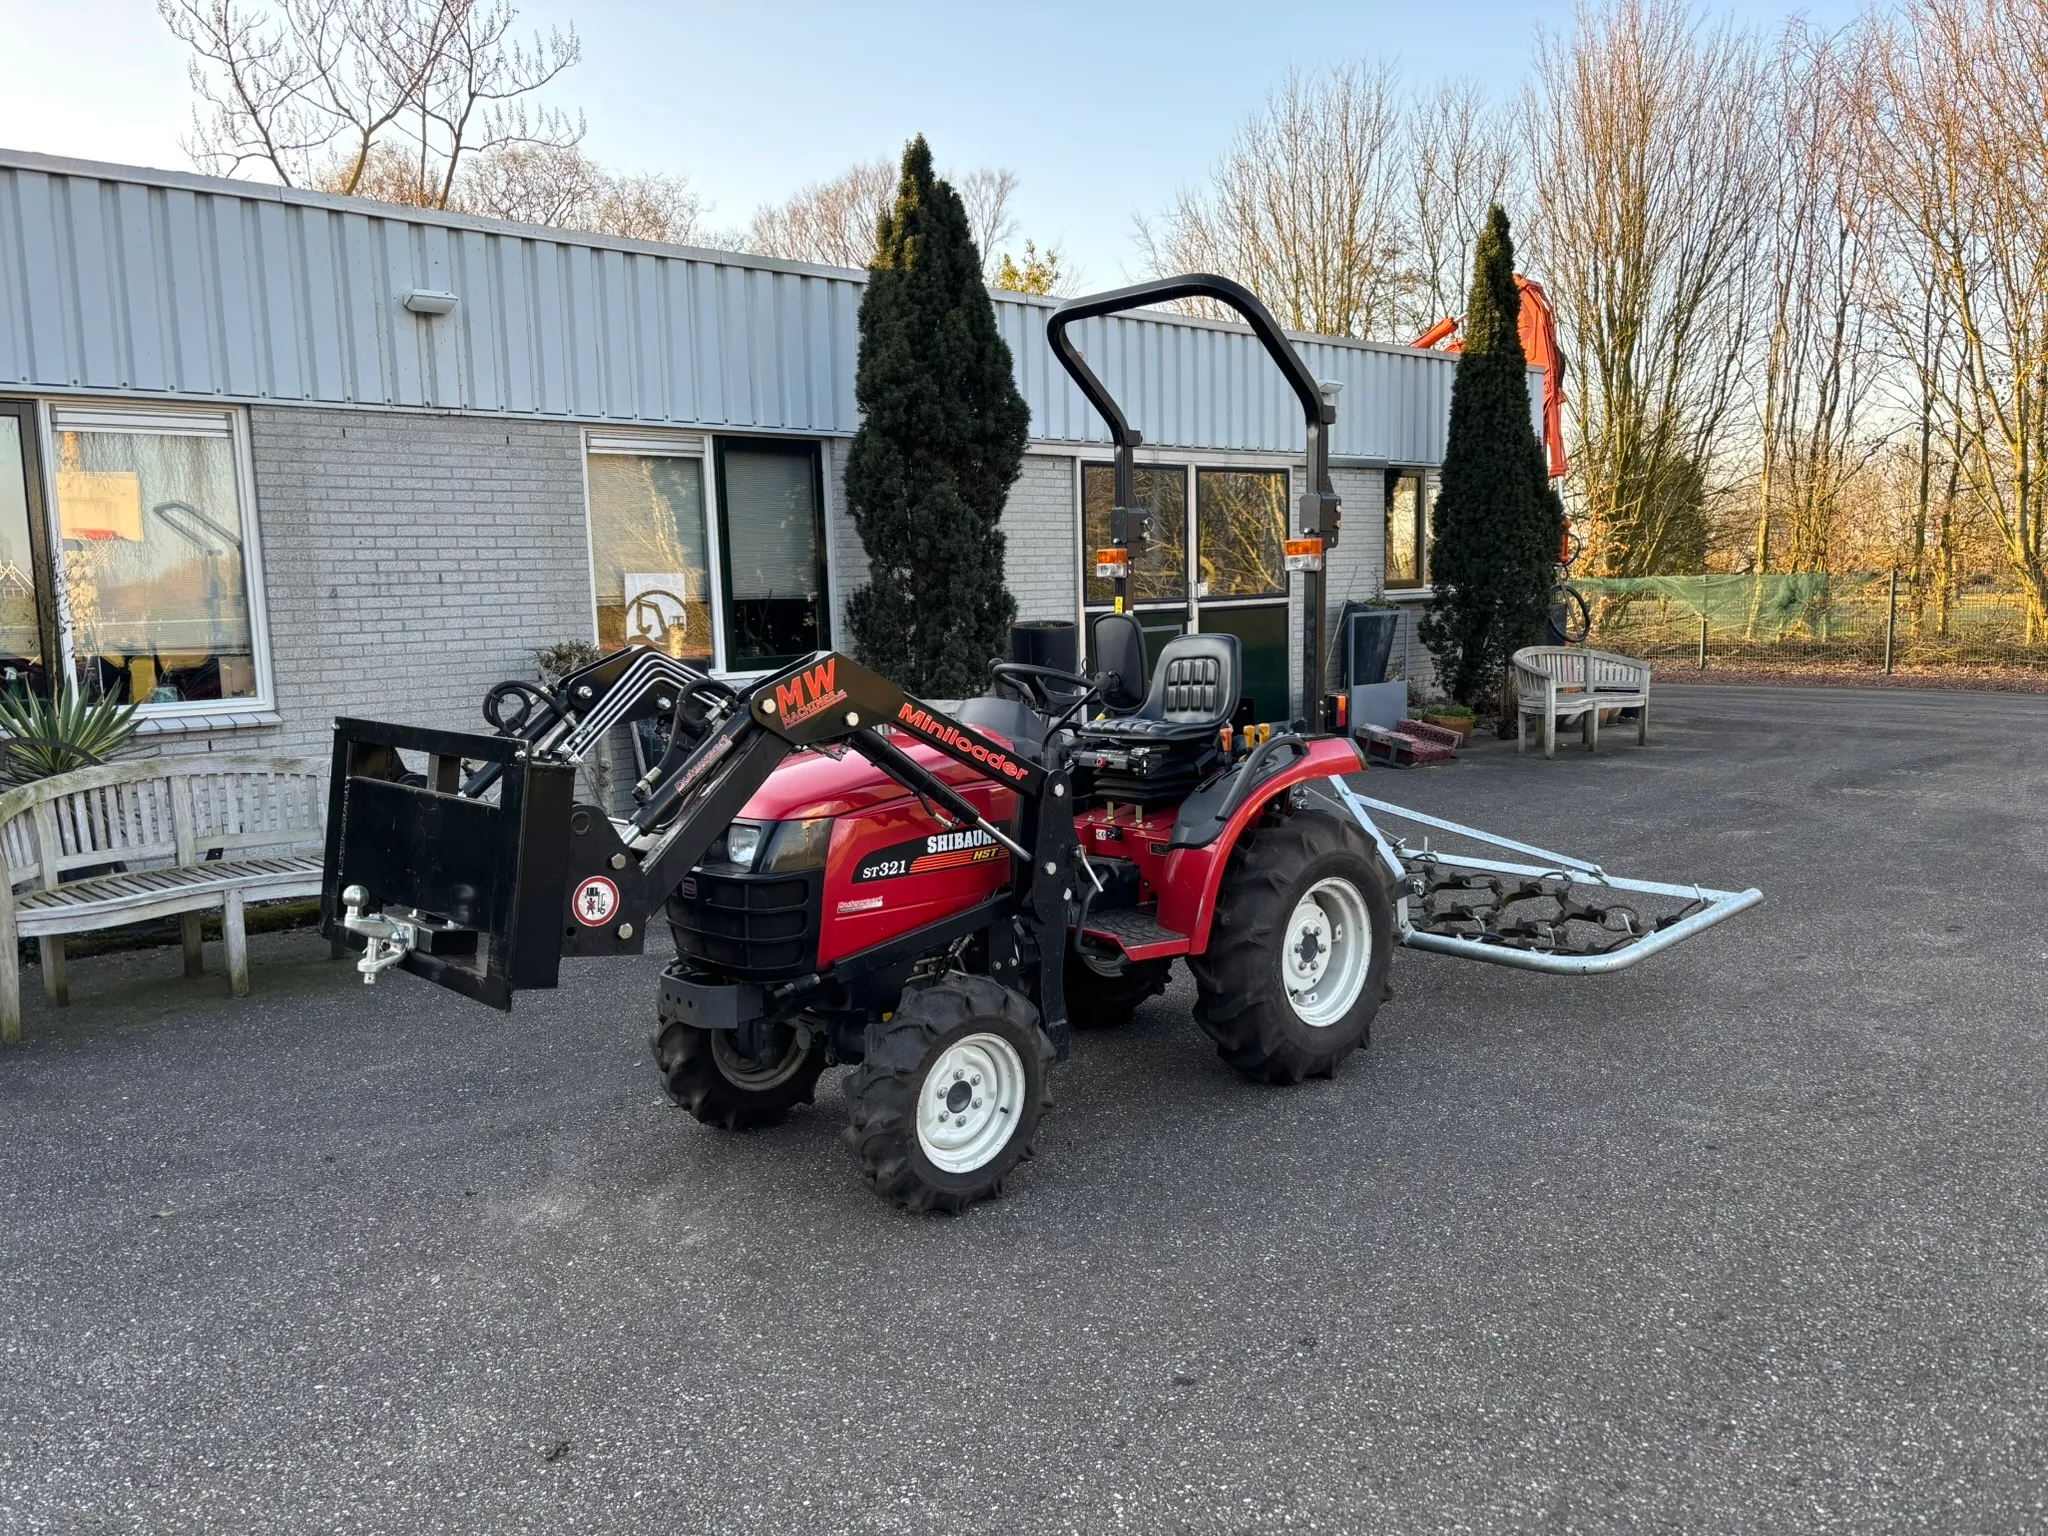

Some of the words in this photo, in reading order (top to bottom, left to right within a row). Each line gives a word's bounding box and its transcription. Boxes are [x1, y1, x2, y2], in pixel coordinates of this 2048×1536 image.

[776, 658, 835, 717] MW
[898, 702, 1029, 781] Miniloader
[927, 827, 1000, 854] SHIBAUR
[973, 847, 999, 861] HST
[862, 860, 906, 878] ST321
